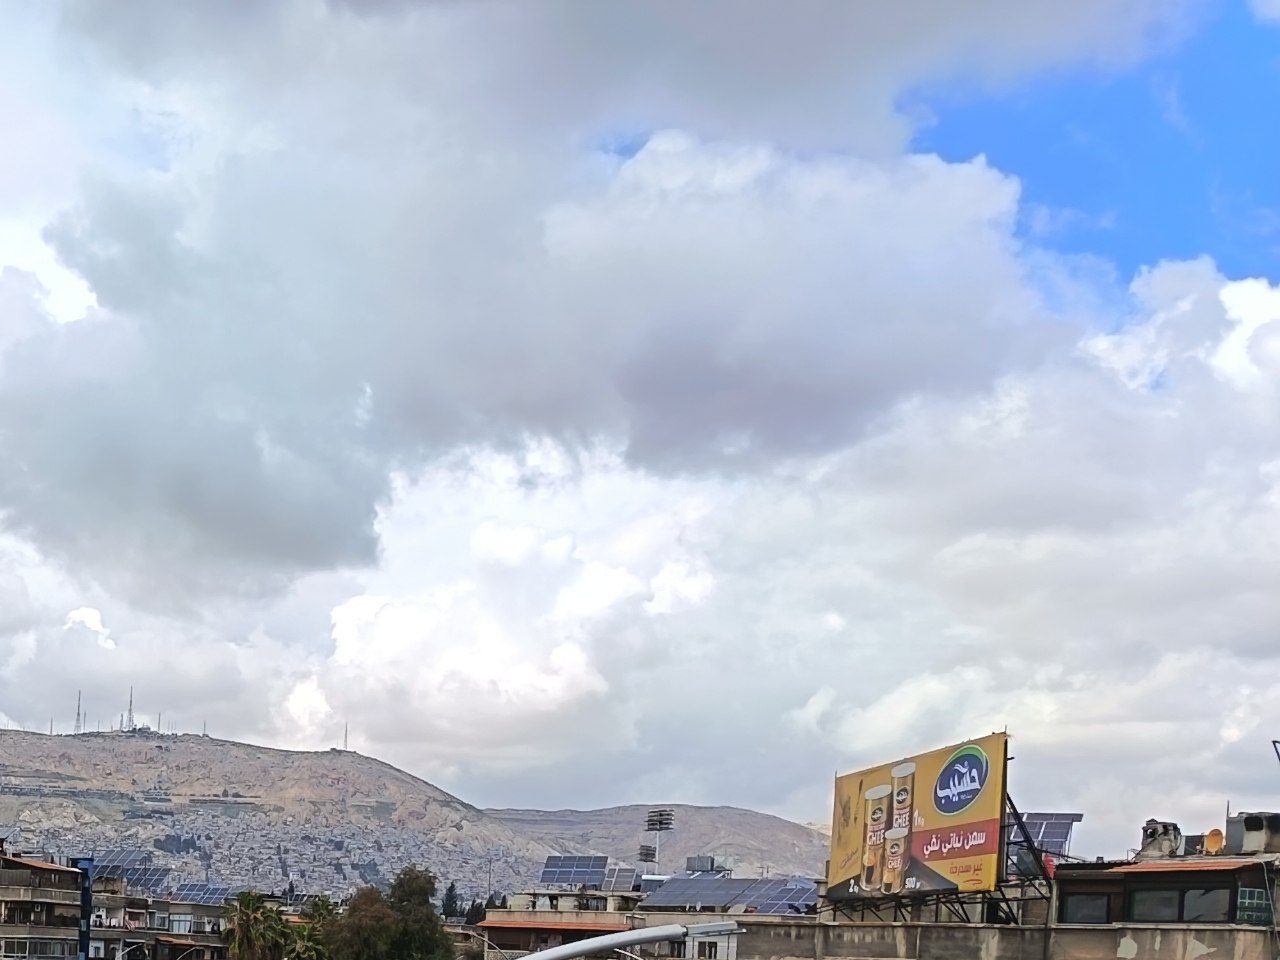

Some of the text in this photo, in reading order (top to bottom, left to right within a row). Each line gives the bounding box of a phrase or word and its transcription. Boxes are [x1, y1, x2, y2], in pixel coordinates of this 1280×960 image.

[893, 812, 910, 828] GHEE
[923, 830, 986, 858] سمن نباتي نقي
